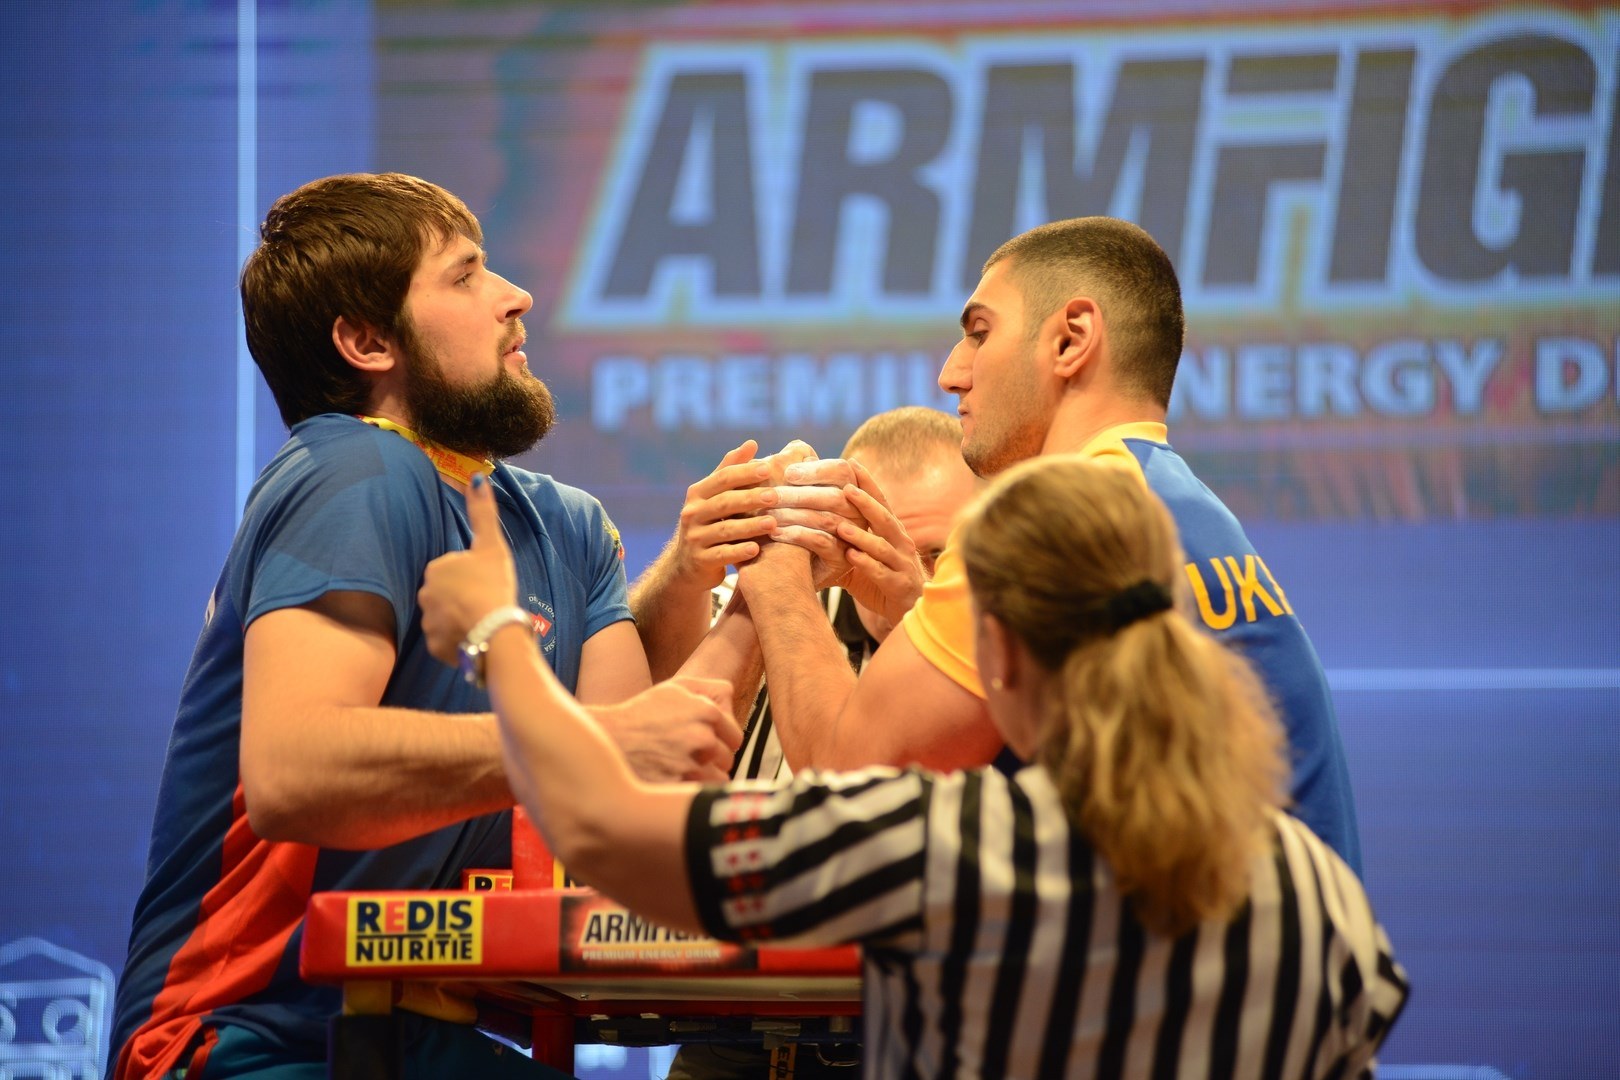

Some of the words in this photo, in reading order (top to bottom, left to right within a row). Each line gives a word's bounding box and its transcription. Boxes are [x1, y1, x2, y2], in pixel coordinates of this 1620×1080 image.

[1166, 338, 1500, 423] NERGY
[1535, 335, 1620, 413] D
[1184, 554, 1293, 630] UK
[357, 900, 473, 932] REDIS
[355, 934, 473, 962] NUTRITIE
[582, 949, 636, 961] PREMIUM
[638, 949, 682, 960] ENERGY
[685, 948, 721, 959] DRINK
